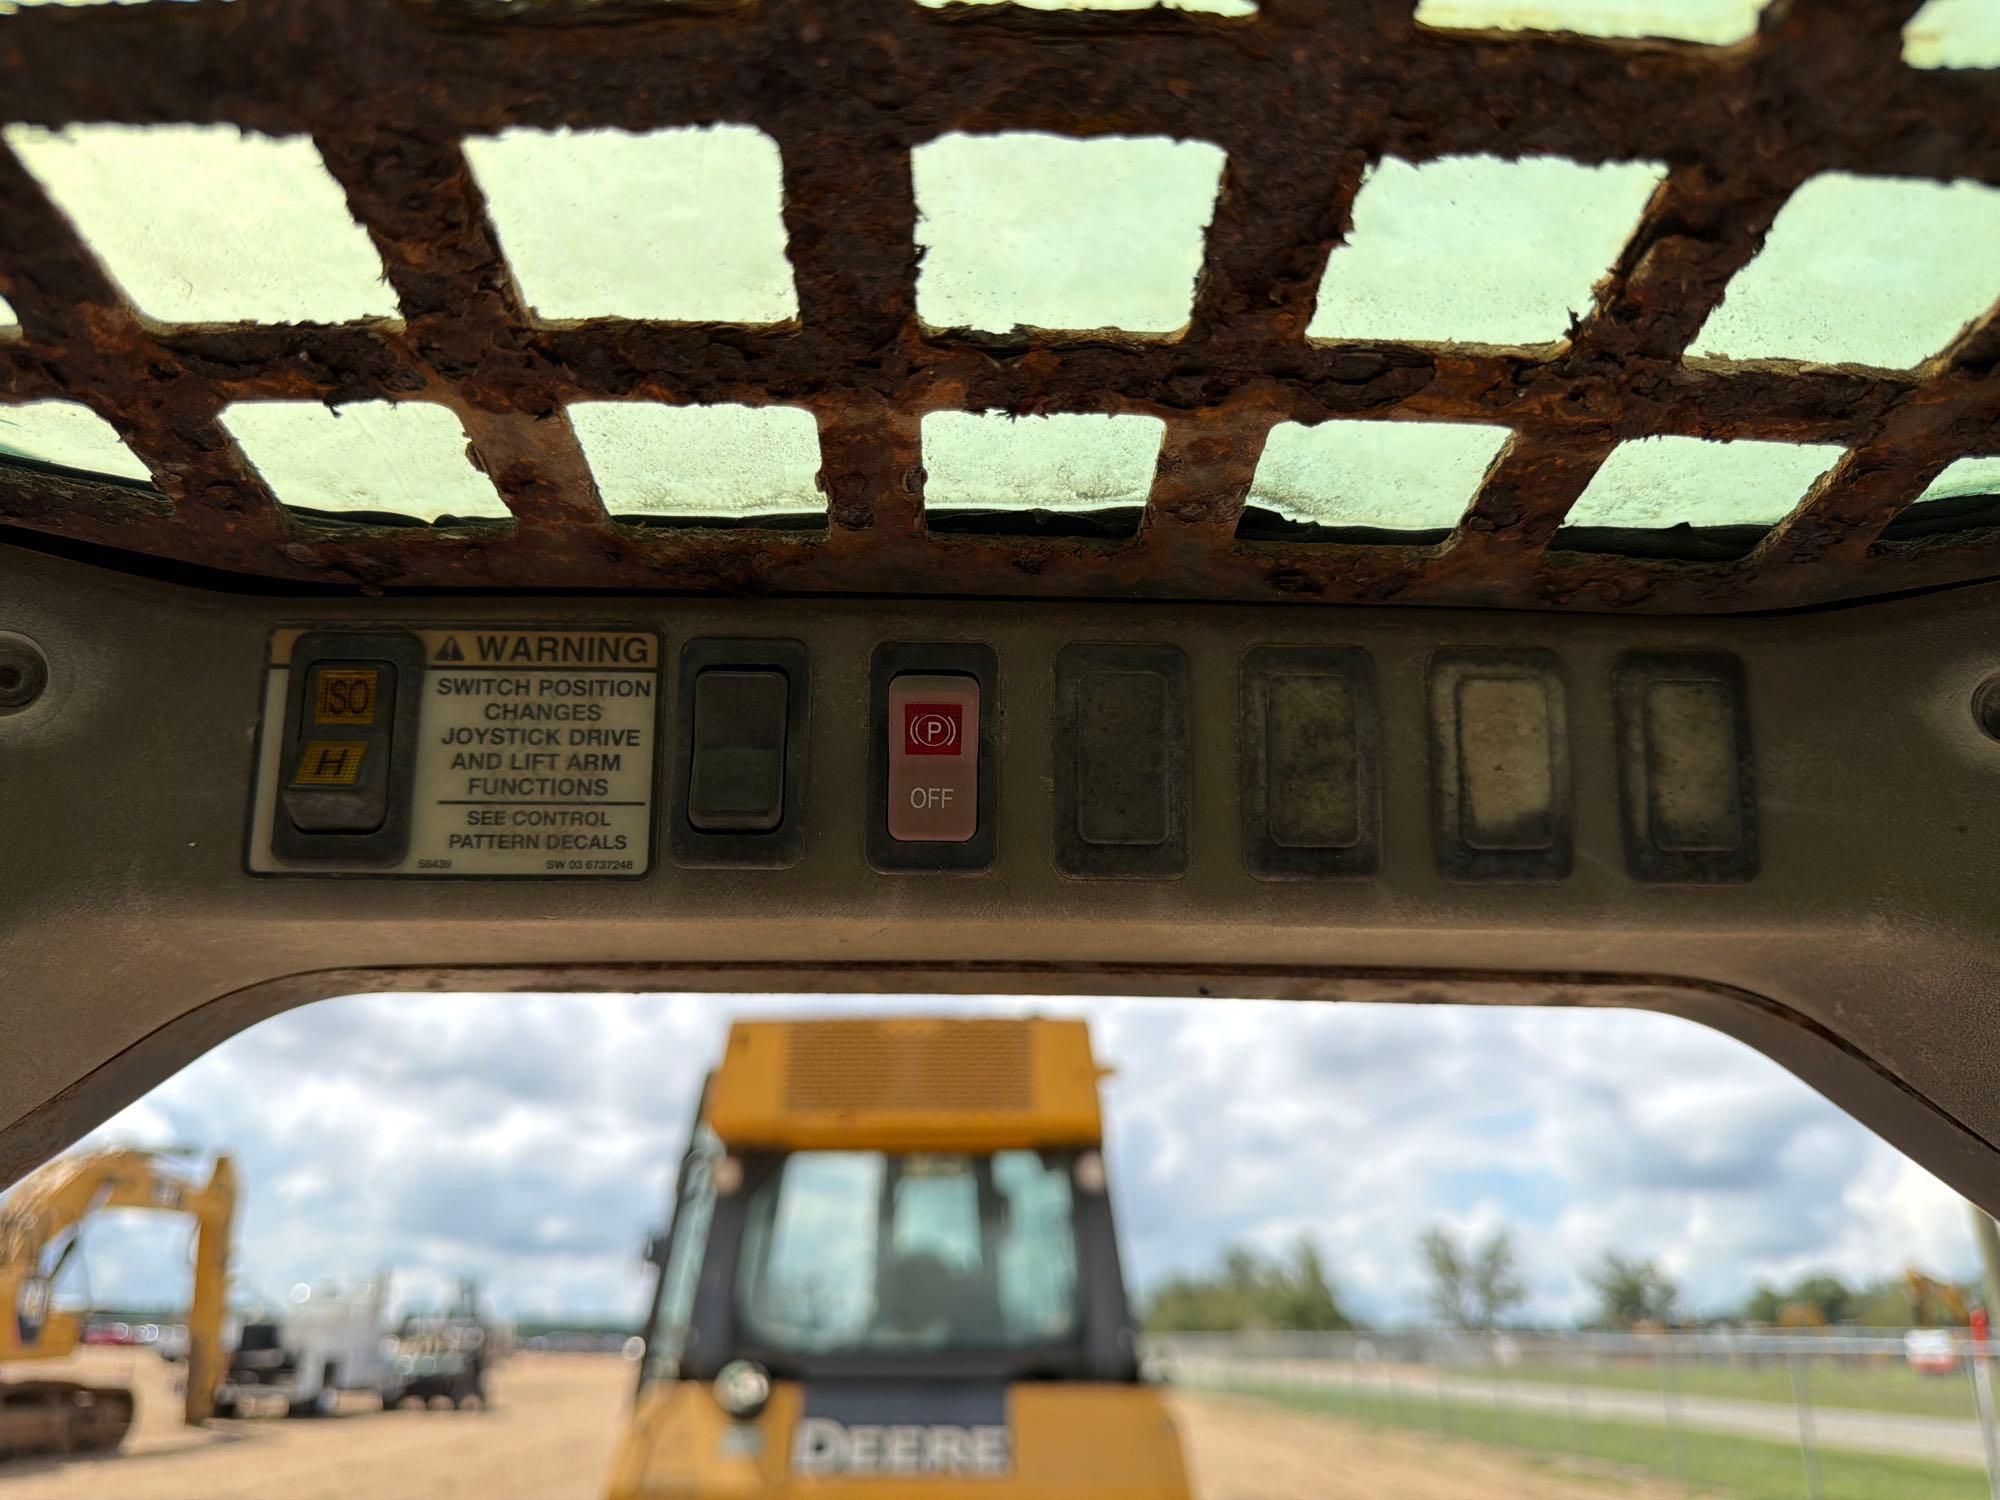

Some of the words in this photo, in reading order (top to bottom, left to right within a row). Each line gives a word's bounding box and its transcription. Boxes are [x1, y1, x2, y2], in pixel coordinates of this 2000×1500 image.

[477, 635, 650, 663] WARNING
[322, 677, 370, 716] ISO
[437, 677, 532, 697] SWITCH
[538, 679, 652, 698] POSITION
[484, 702, 603, 721] CHANGES
[441, 726, 563, 746] JOYSTICK
[569, 729, 641, 747] DRIVE
[315, 749, 348, 777] H
[451, 752, 506, 770] AND
[511, 753, 561, 771] LIFT
[568, 753, 622, 771] ARM
[468, 777, 609, 797] FUNCTIONS
[910, 787, 954, 809] OFF
[467, 810, 507, 827] SEE
[513, 810, 612, 828] CONTROL
[449, 834, 545, 850] PATTERN
[547, 834, 628, 851] DECALS
[545, 860, 566, 871] SW
[569, 860, 584, 871] 03
[585, 860, 634, 872] 6737248
[795, 1417, 1011, 1472] DEERE
